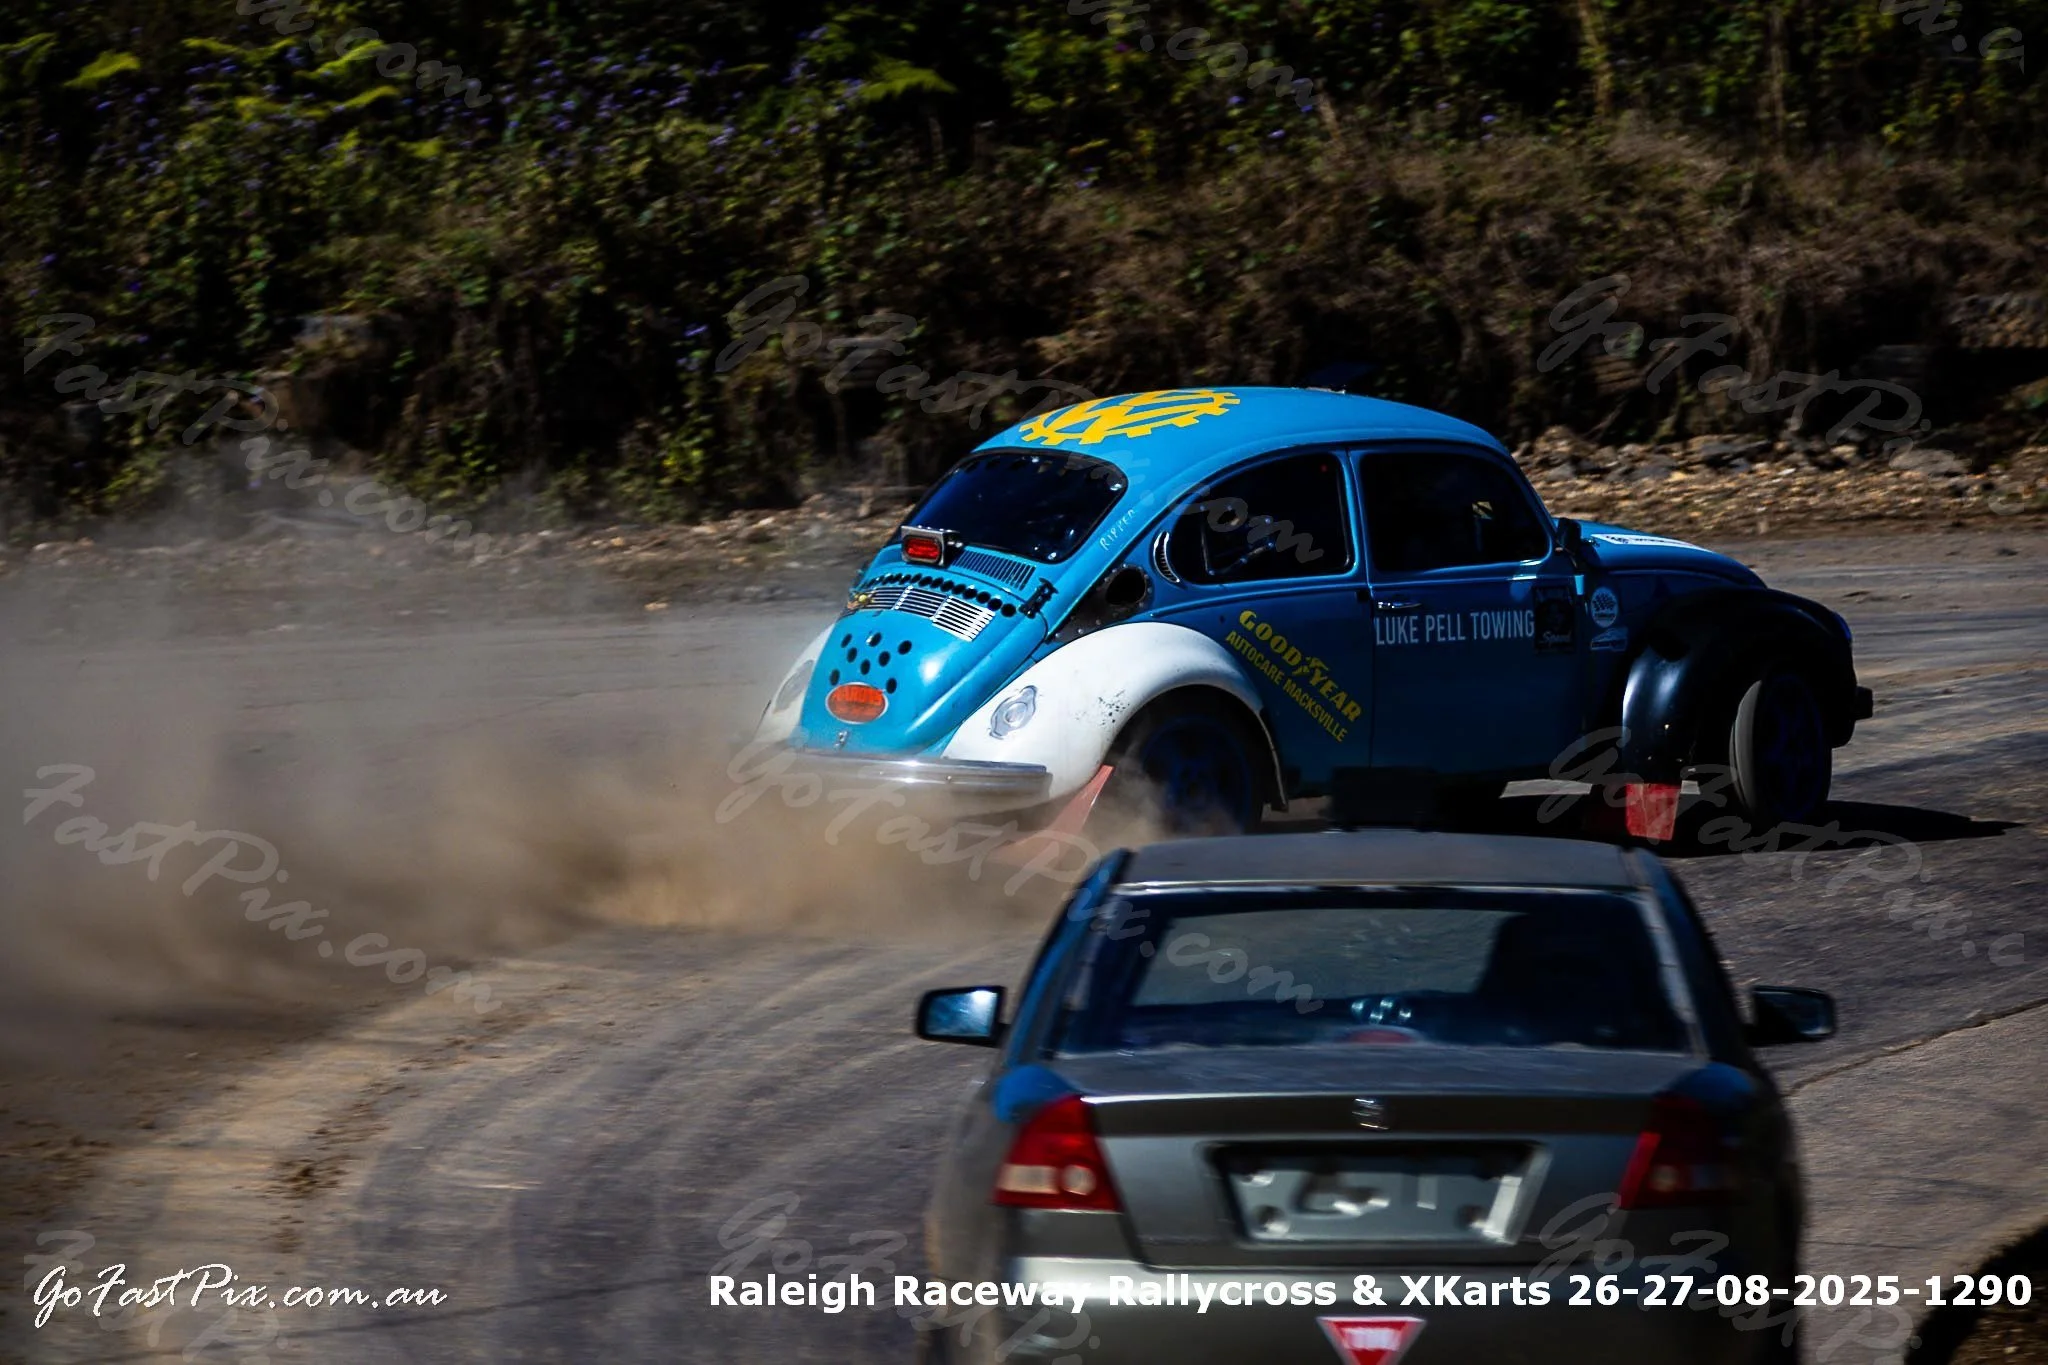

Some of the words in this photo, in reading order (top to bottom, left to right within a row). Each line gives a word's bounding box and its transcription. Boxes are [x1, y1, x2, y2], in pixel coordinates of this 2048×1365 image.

[1239, 610, 1362, 721] GOODYEAR
[1376, 615, 1419, 645] LUKE
[1426, 614, 1466, 642] PELL
[1470, 610, 1535, 639] TOWING
[1225, 631, 1285, 685] AUTOCARE
[1283, 679, 1348, 742] MACKSVILLE
